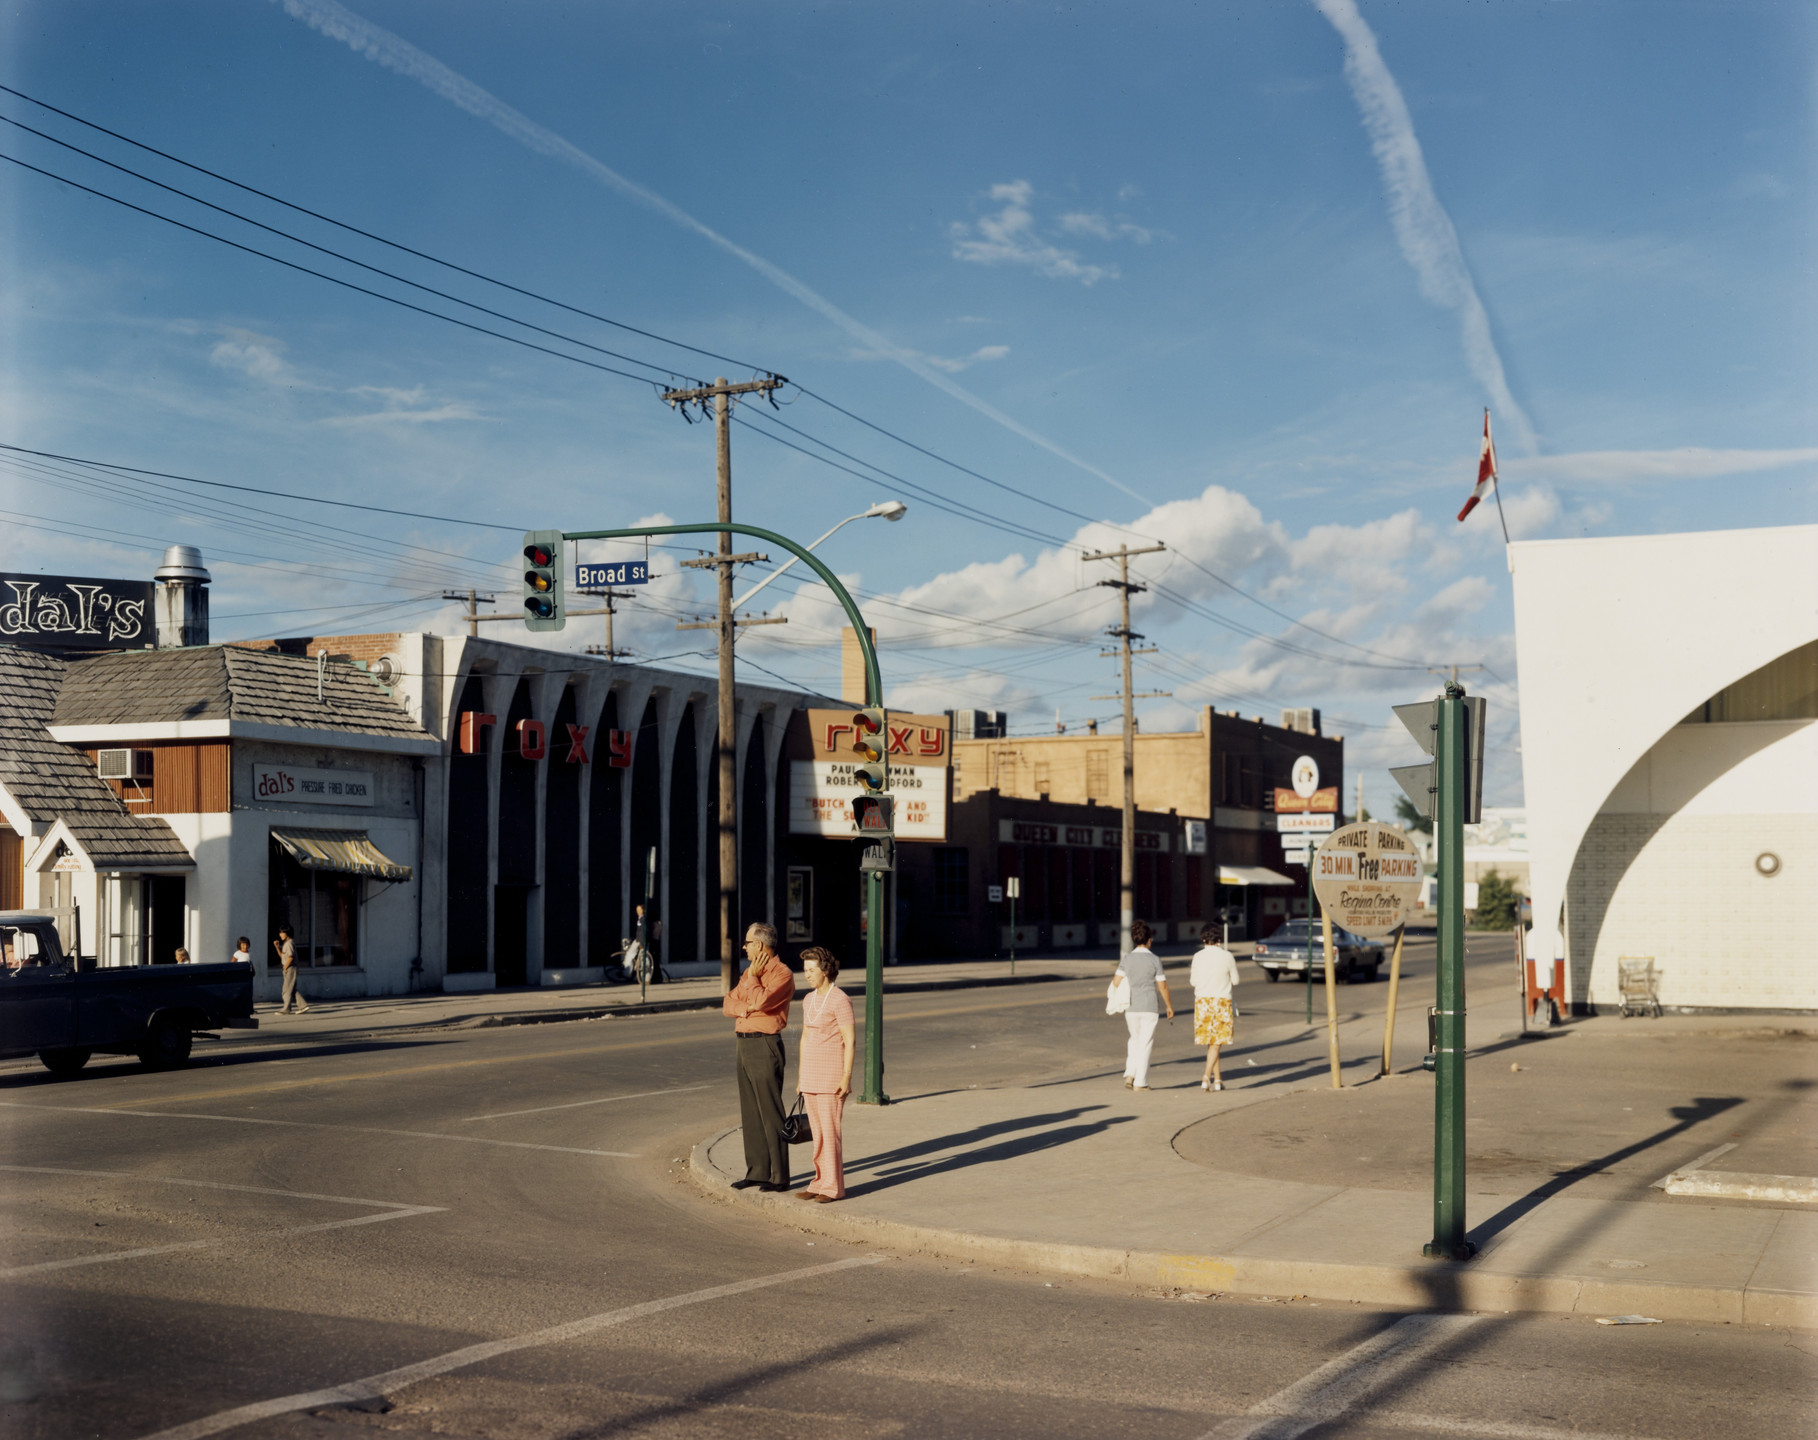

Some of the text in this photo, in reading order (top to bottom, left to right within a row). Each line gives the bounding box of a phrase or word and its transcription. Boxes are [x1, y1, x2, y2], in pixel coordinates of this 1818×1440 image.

[579, 564, 645, 585] Broad St
[459, 711, 632, 768] roxy
[825, 723, 945, 756] rxy
[831, 765, 856, 774] PAUL
[258, 771, 367, 797] dal's PRESSURE FRIED CHICKEN
[826, 776, 922, 788] ROBER DFORD
[813, 810, 832, 820] THE
[907, 802, 927, 811] AND
[1281, 818, 1331, 828] CLEANERS
[1012, 822, 1161, 849] QUEEN CITY CLENERS
[1338, 830, 1405, 850] PRIVATE PARKING
[864, 845, 885, 858] WAL
[1321, 852, 1417, 880] 30 MIN. Free PARKING
[1340, 890, 1401, 912] Regina Centre
[1346, 916, 1361, 926] SPEED
[1363, 916, 1376, 926] LIMIT
